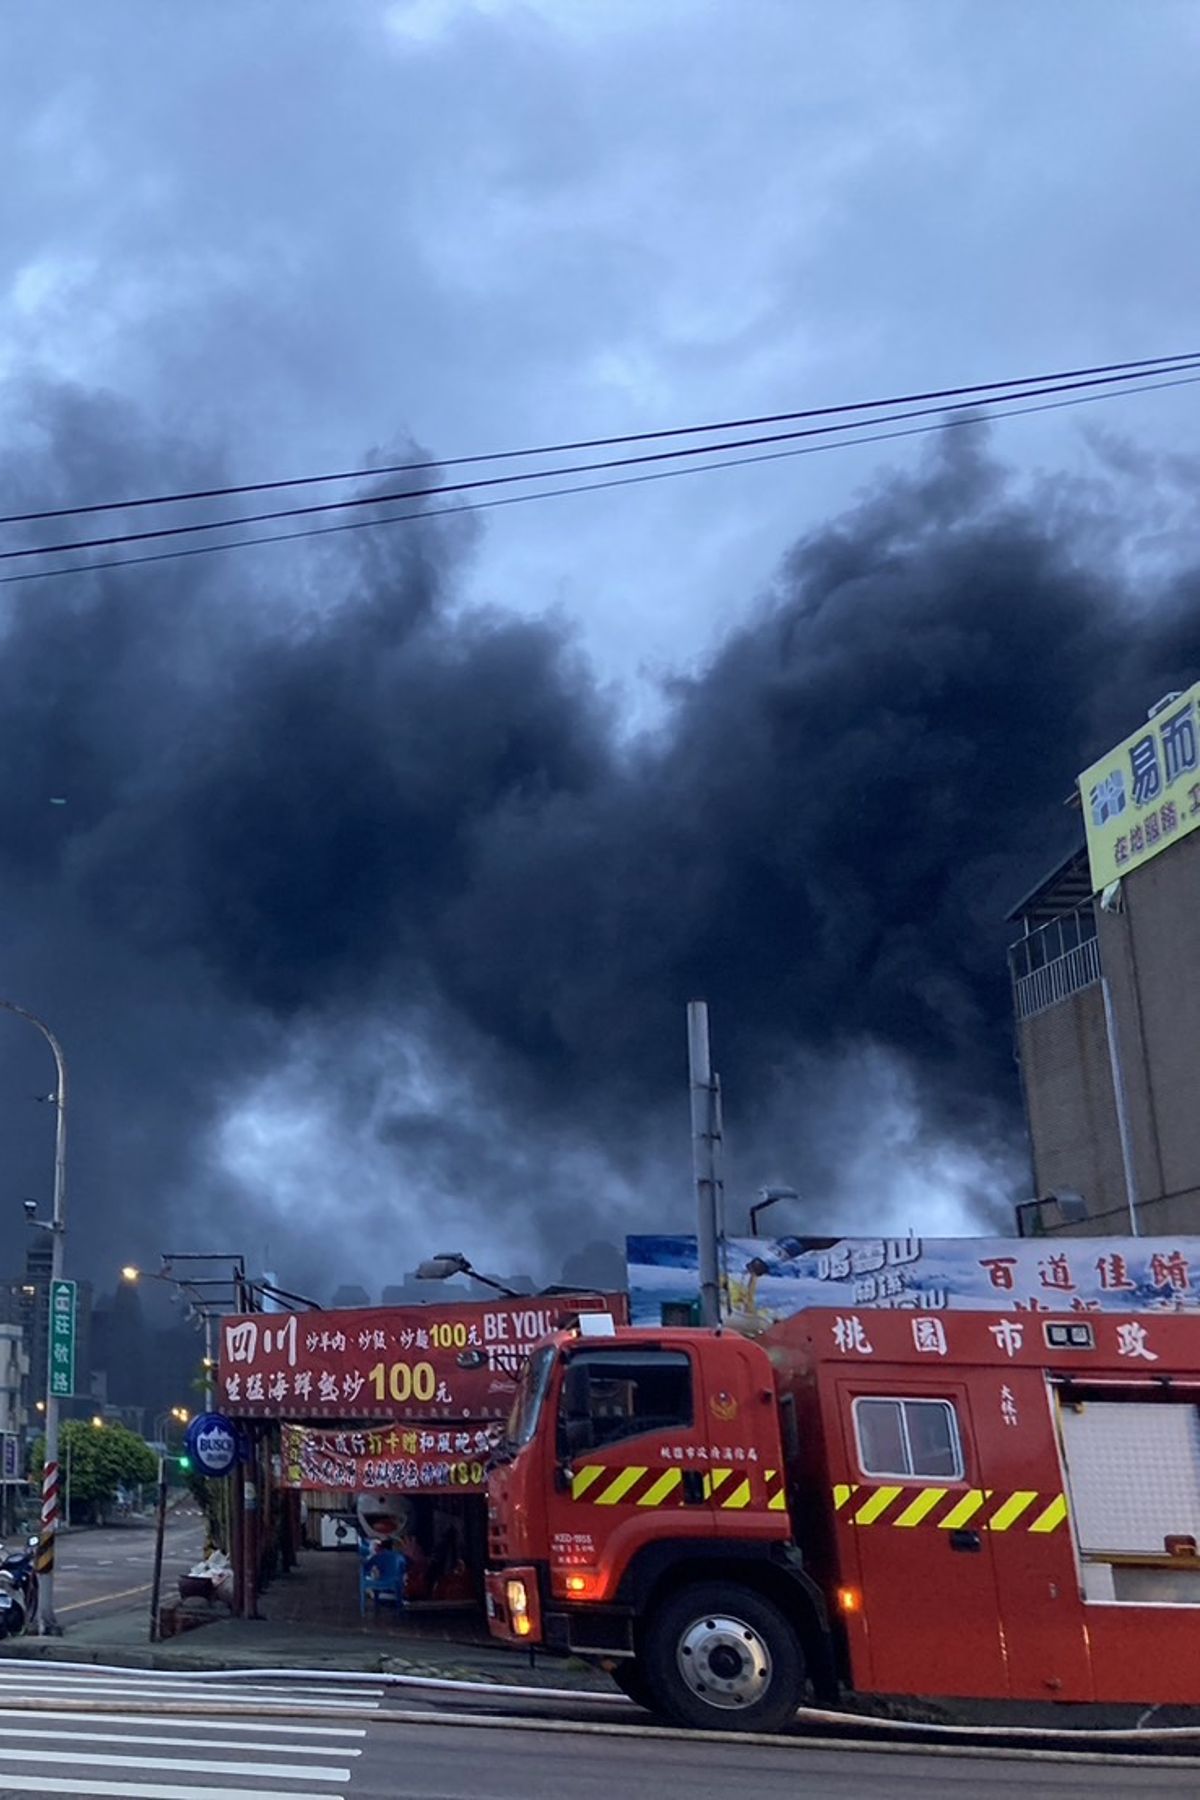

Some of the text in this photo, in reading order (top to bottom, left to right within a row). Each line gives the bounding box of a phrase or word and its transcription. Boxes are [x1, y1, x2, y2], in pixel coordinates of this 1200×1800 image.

[979, 1250, 1190, 1291] 百道佳餚
[226, 1315, 297, 1367] 四川
[484, 1308, 559, 1340] BE YOU
[832, 1316, 1158, 1361] 桃園市政
